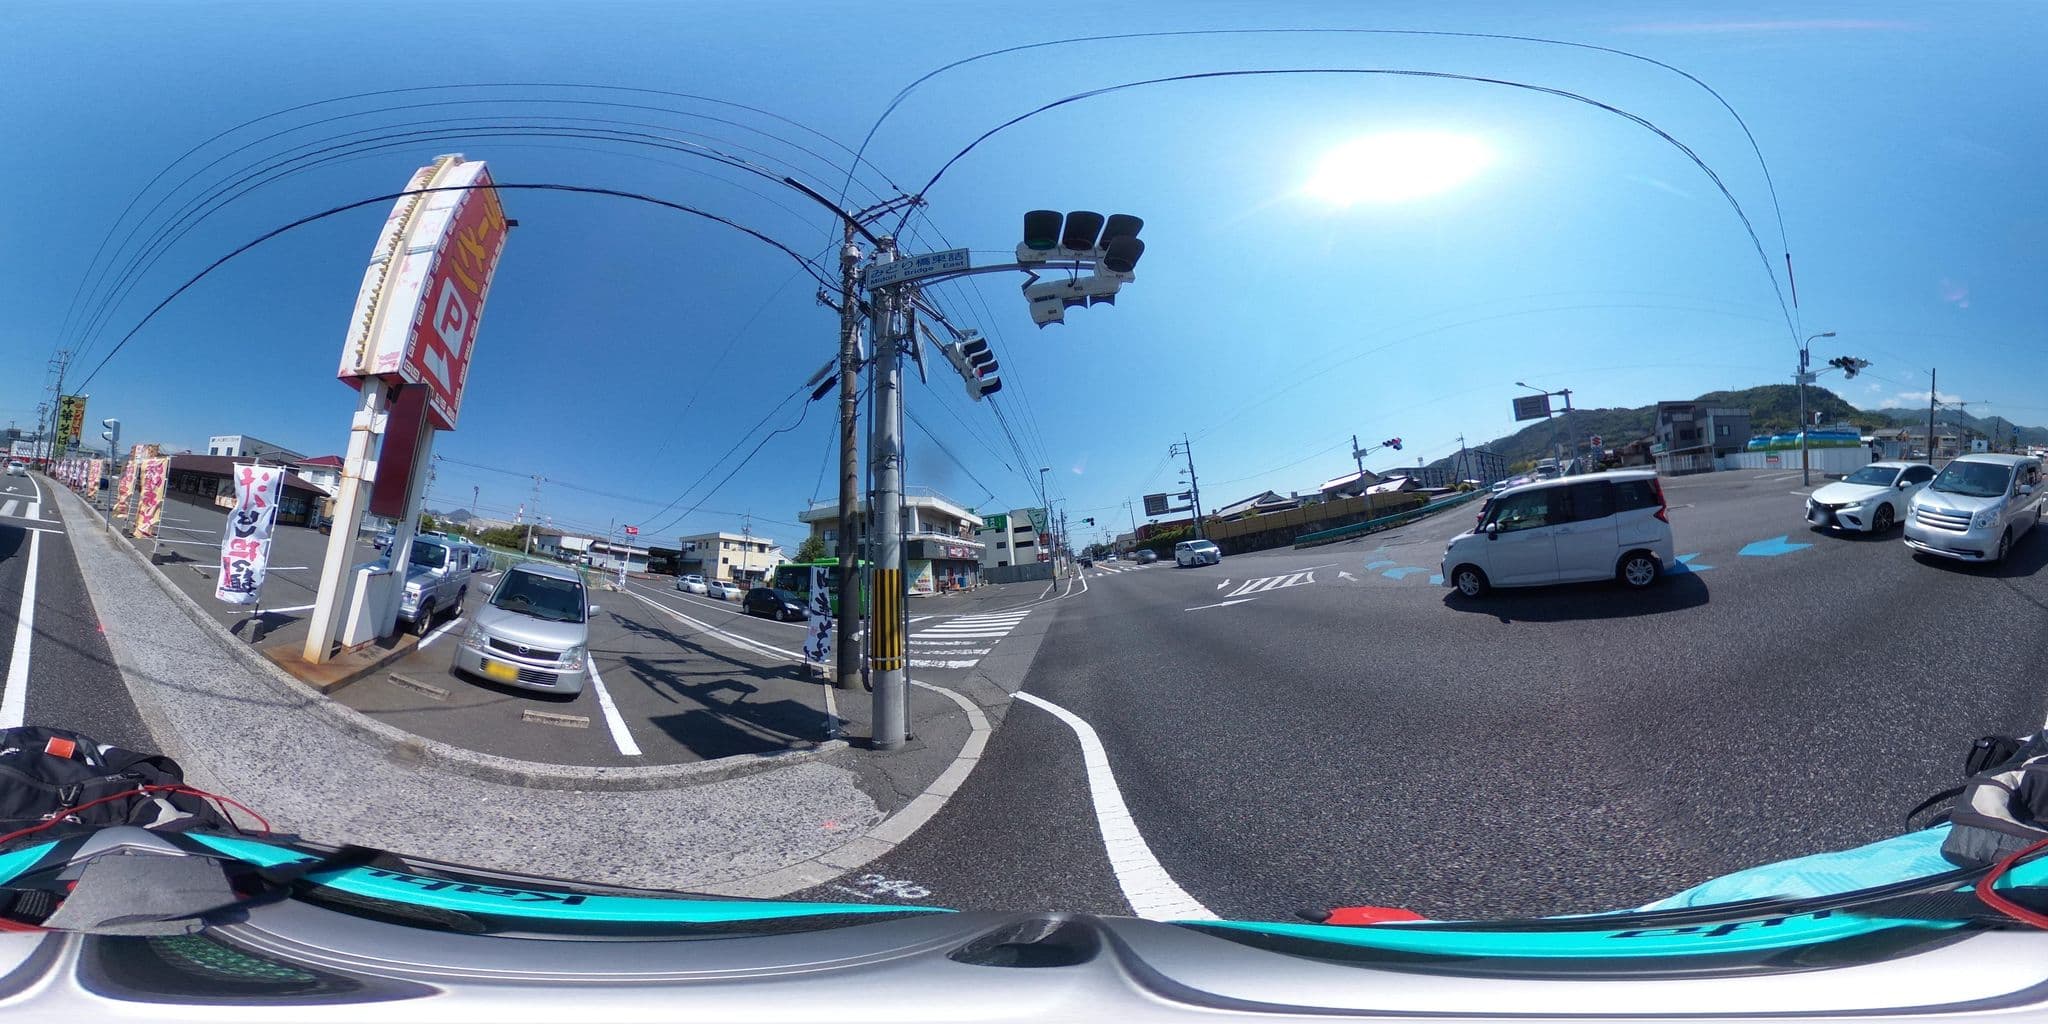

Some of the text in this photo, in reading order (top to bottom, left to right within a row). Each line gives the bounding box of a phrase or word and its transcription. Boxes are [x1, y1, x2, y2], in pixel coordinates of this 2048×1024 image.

[870, 261, 964, 285] Midori Bridge East
[871, 252, 964, 278] みどり橋東詰
[58, 397, 75, 445] 中華そば
